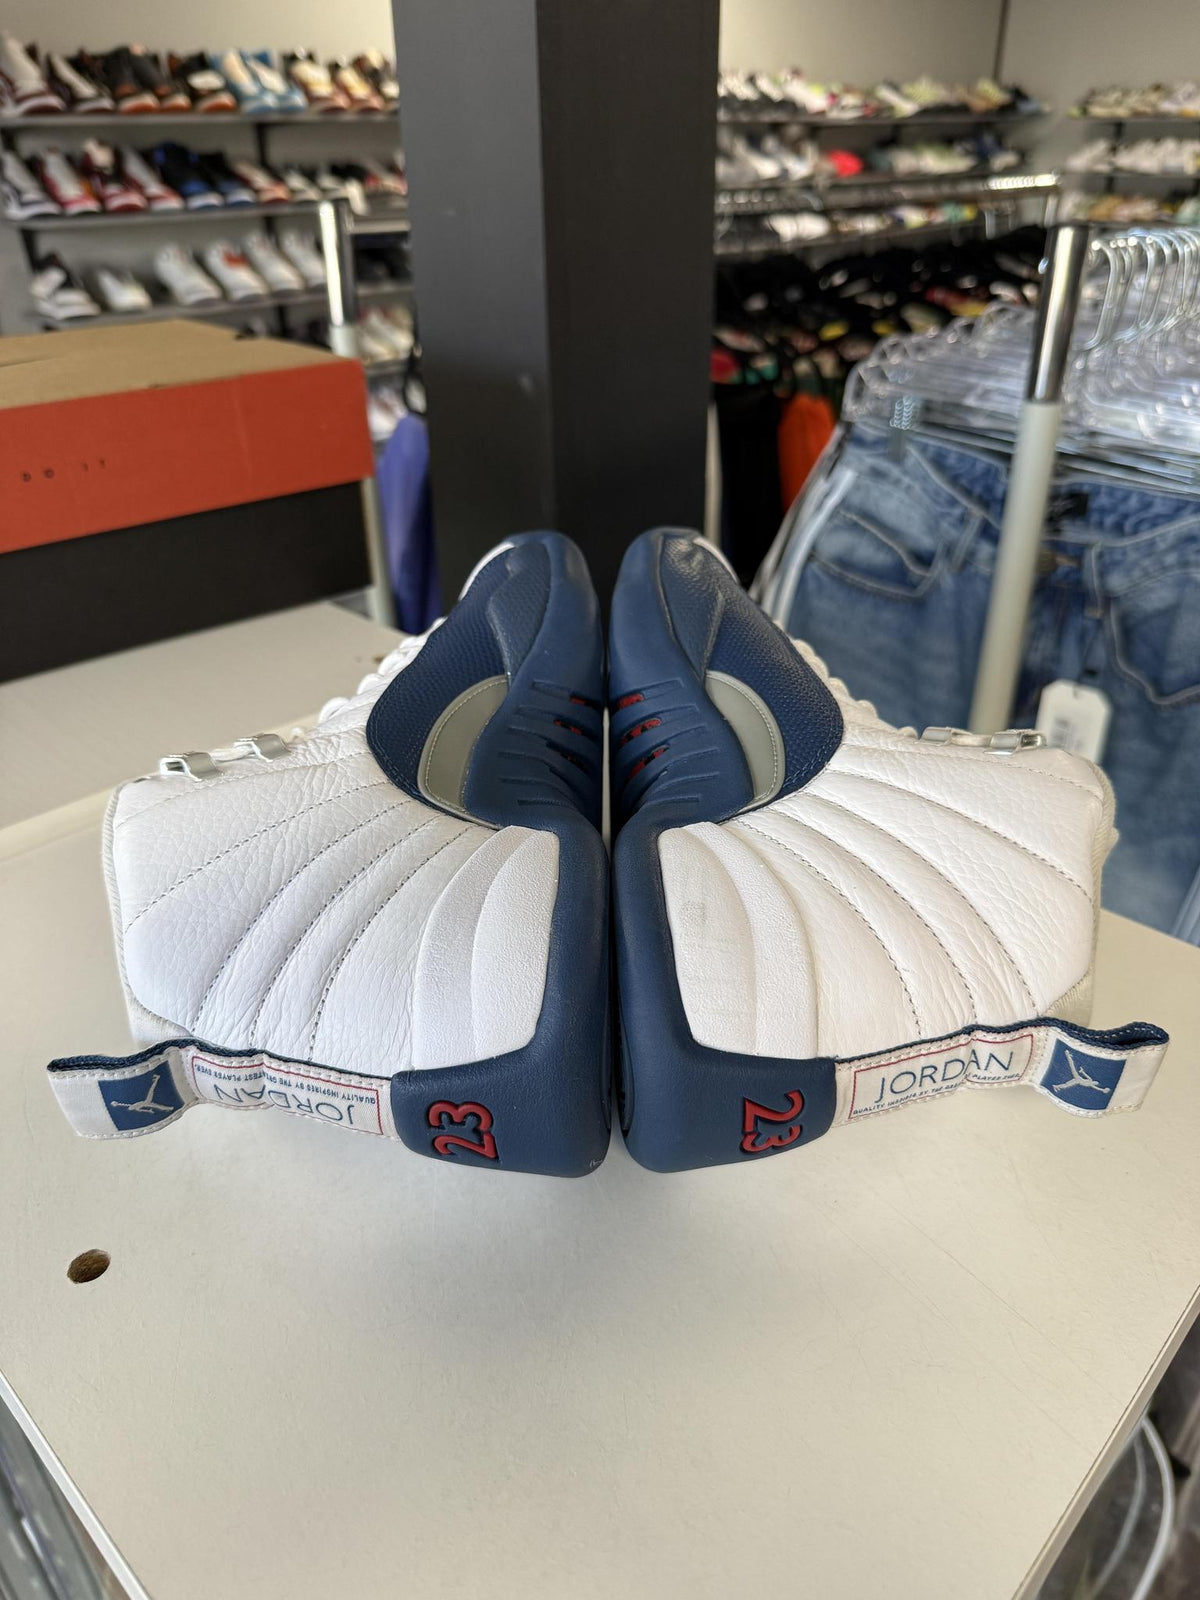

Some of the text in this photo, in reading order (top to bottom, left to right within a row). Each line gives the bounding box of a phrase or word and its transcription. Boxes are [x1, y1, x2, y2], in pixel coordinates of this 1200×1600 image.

[279, 1077, 292, 1087] THE
[296, 1081, 305, 1090] BY
[874, 1049, 1014, 1104] JORDAN
[213, 1083, 355, 1125] JORDAN
[307, 1085, 339, 1098] INSPIRED
[341, 1093, 376, 1105] QUALITY
[428, 1100, 499, 1160] 23
[741, 1089, 805, 1153] 23
